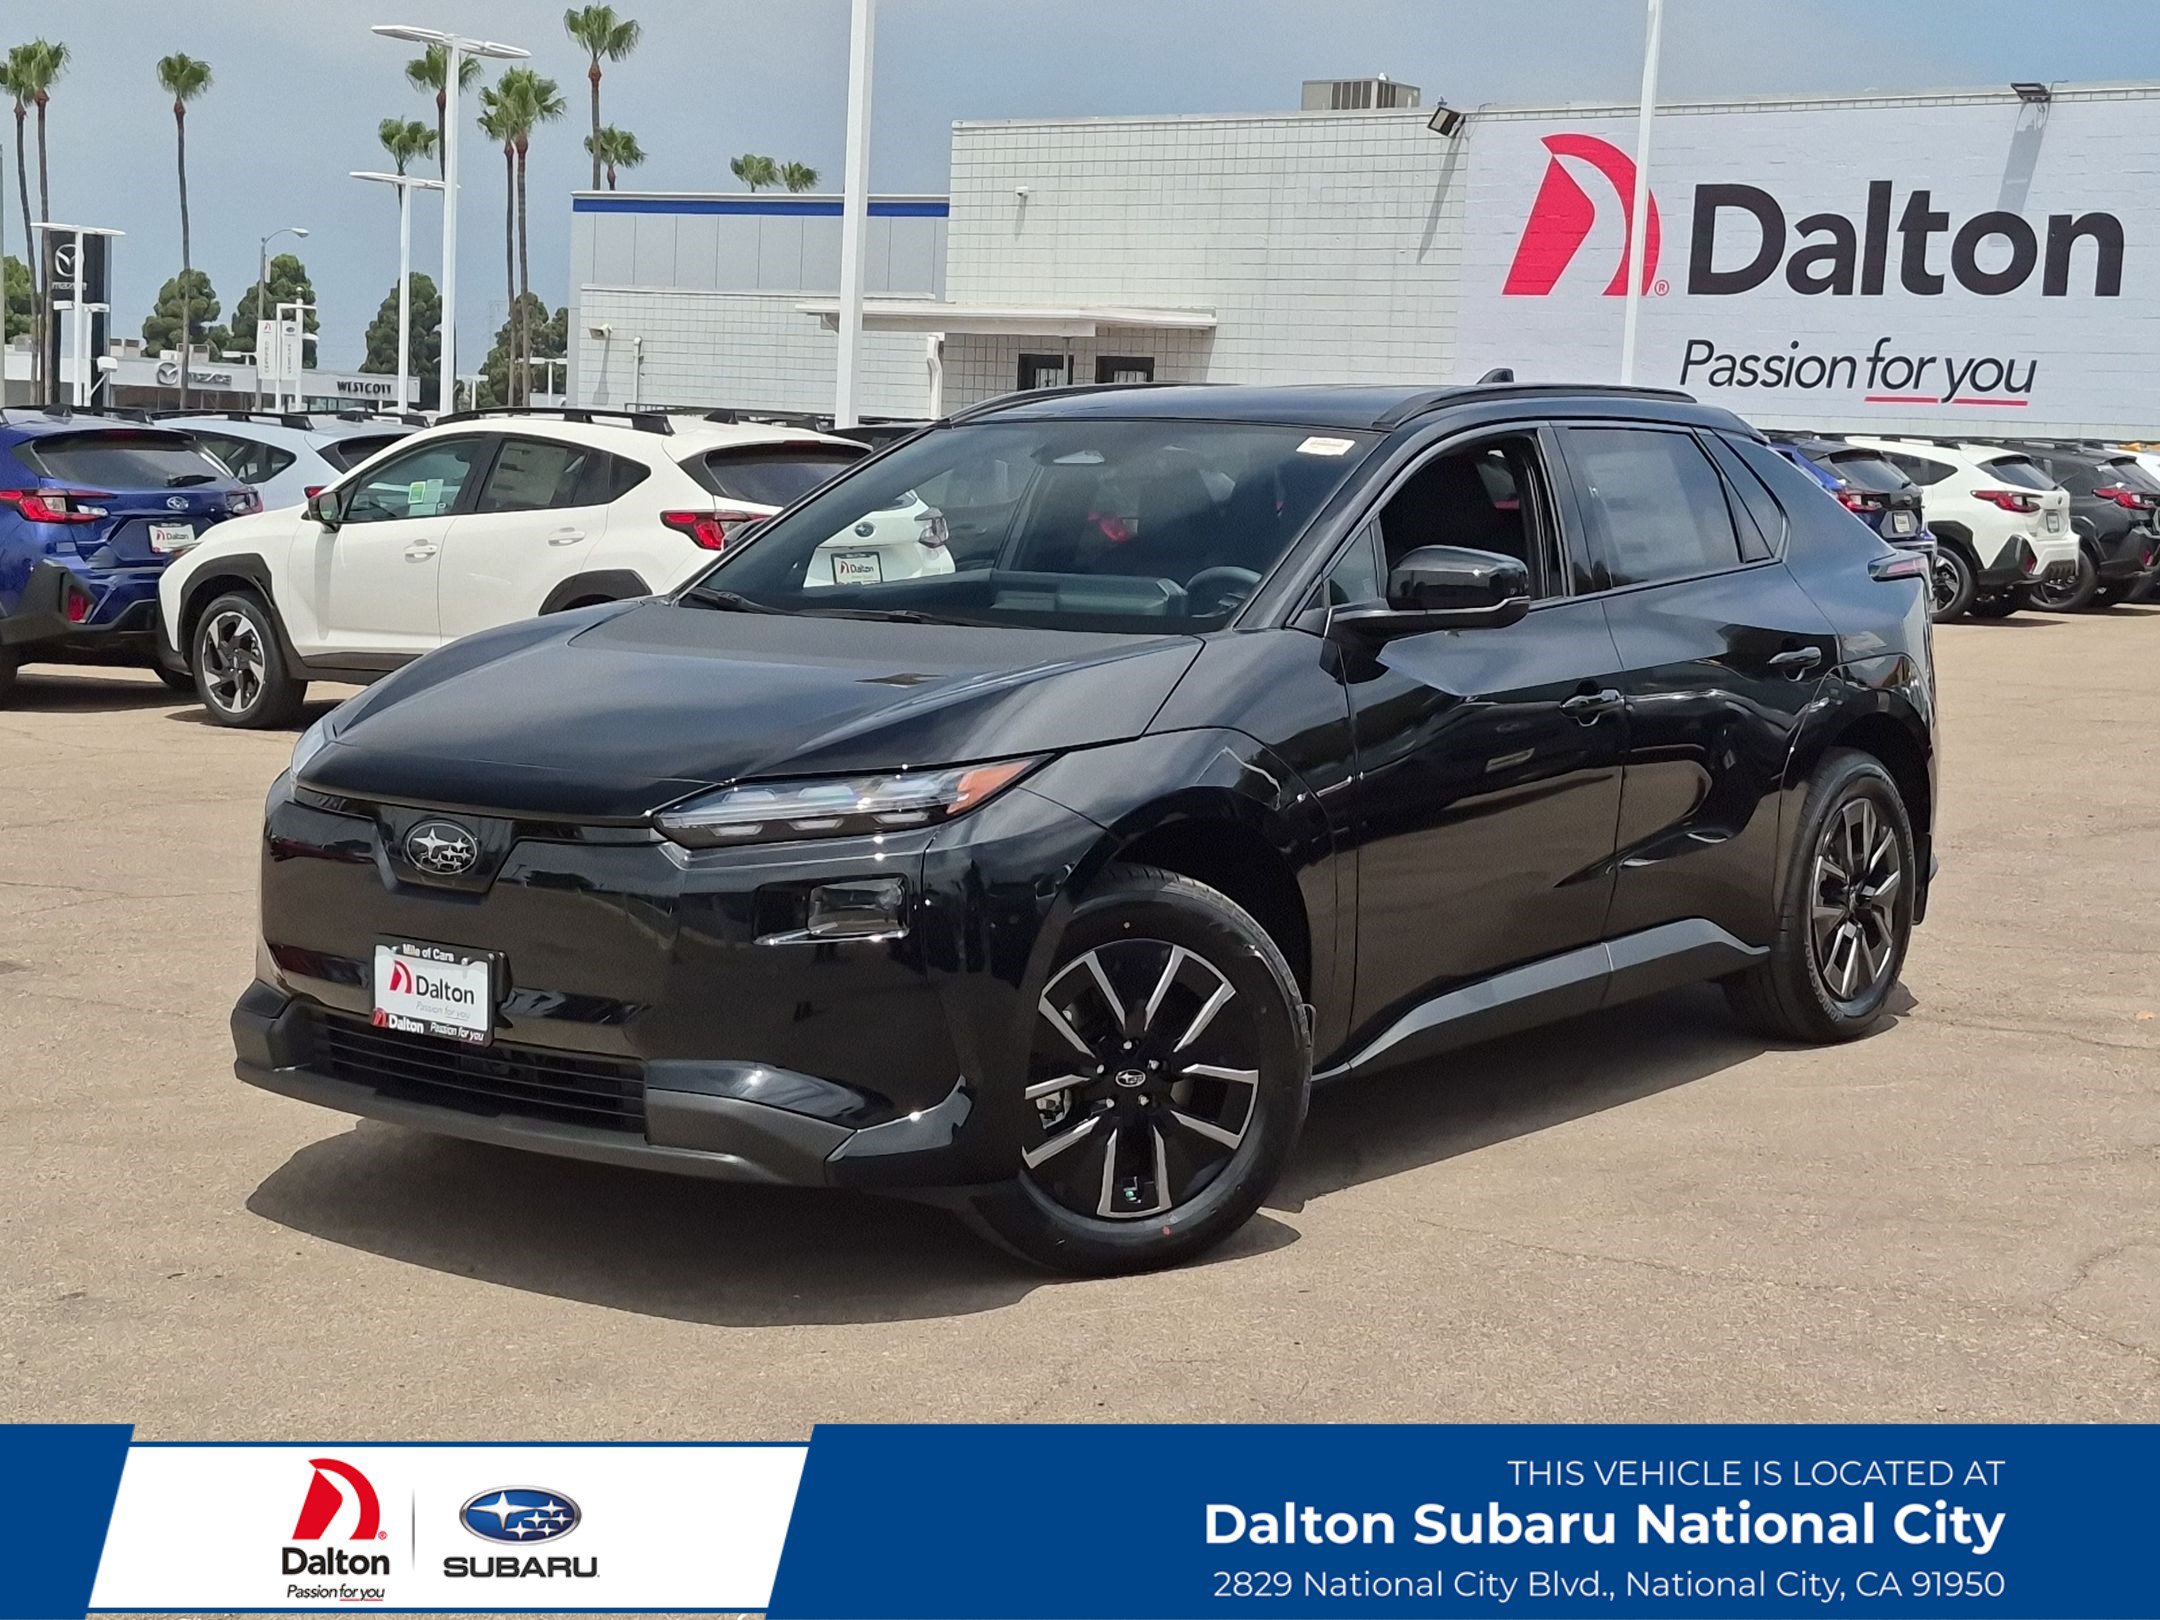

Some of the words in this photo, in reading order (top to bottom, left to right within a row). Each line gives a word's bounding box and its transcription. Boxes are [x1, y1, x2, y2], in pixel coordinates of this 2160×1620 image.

[1687, 180, 2125, 296] Dalton
[51, 281, 88, 291] maza
[1679, 338, 1858, 390] Passion
[1864, 336, 1938, 399] for
[1939, 357, 2037, 403] you
[402, 943, 420, 957] Mile
[421, 947, 432, 959] of
[432, 949, 455, 962] Cars
[415, 974, 475, 1005] Dalton
[388, 1014, 425, 1034] Dalton
[430, 1022, 457, 1036] Passion
[458, 1026, 469, 1038] for
[469, 1031, 485, 1042] you
